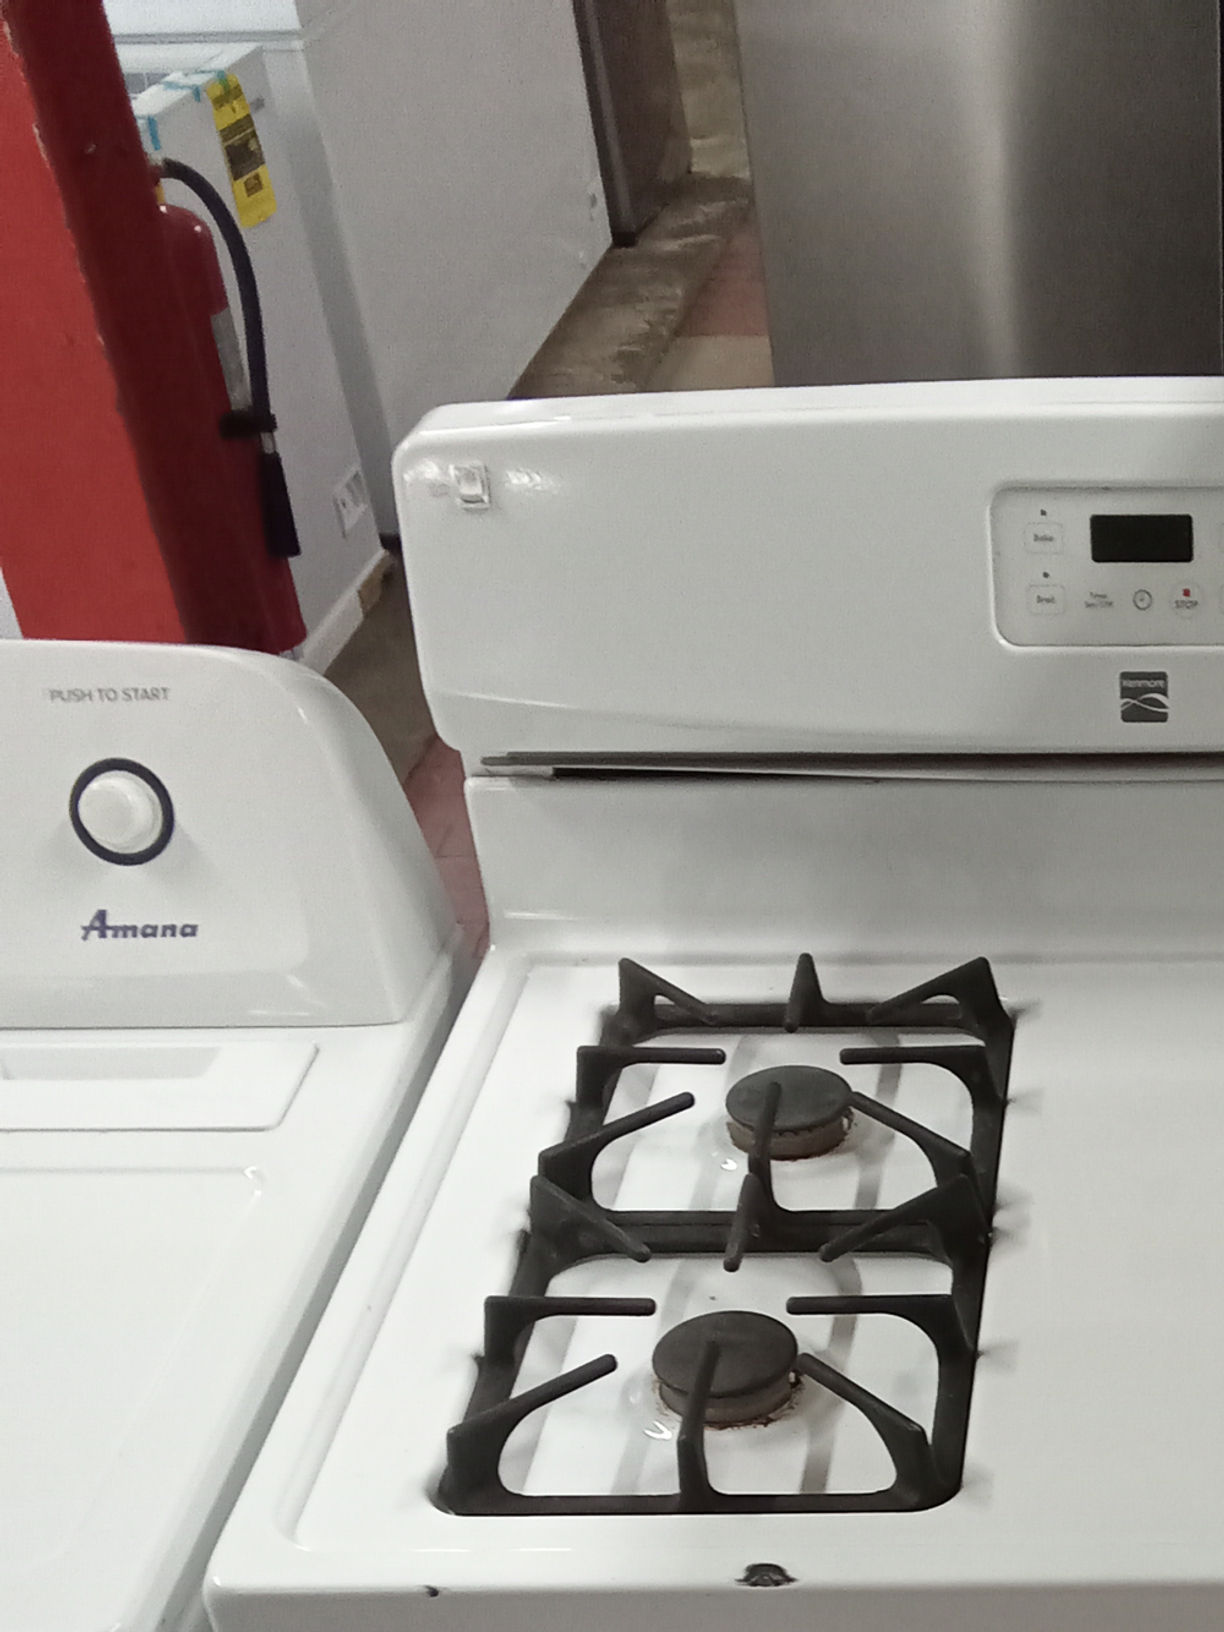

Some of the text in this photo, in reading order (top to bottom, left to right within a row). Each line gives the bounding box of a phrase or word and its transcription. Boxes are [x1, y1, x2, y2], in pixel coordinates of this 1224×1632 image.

[50, 687, 170, 702] PUSH TO START
[80, 908, 199, 941] Amana
